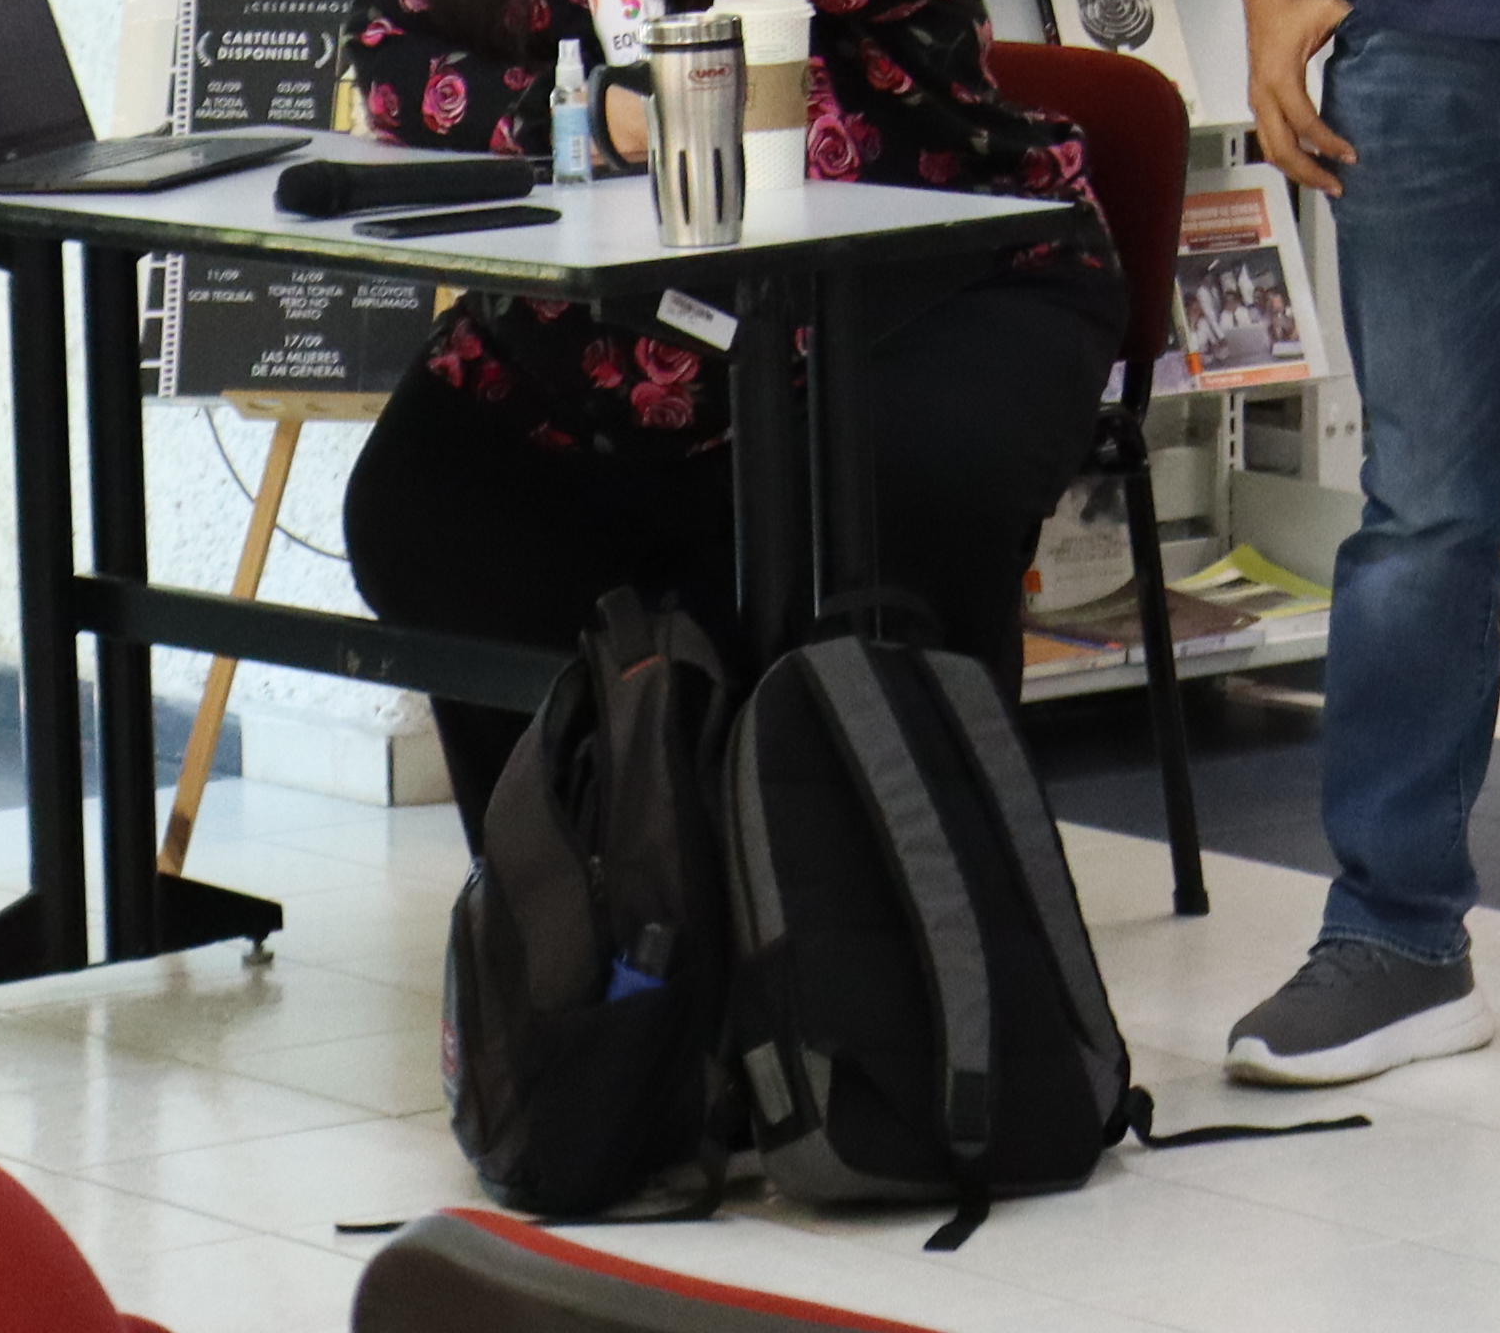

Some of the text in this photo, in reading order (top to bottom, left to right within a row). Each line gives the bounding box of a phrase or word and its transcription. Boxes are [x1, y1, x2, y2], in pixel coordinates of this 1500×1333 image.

[222, 31, 308, 46] CARTELERA
[216, 46, 310, 61] DISPONIBLE
[283, 335, 323, 349] 17/09
[261, 351, 340, 364] LAS MUJERES
[251, 364, 346, 378] DE MI GENERAL
